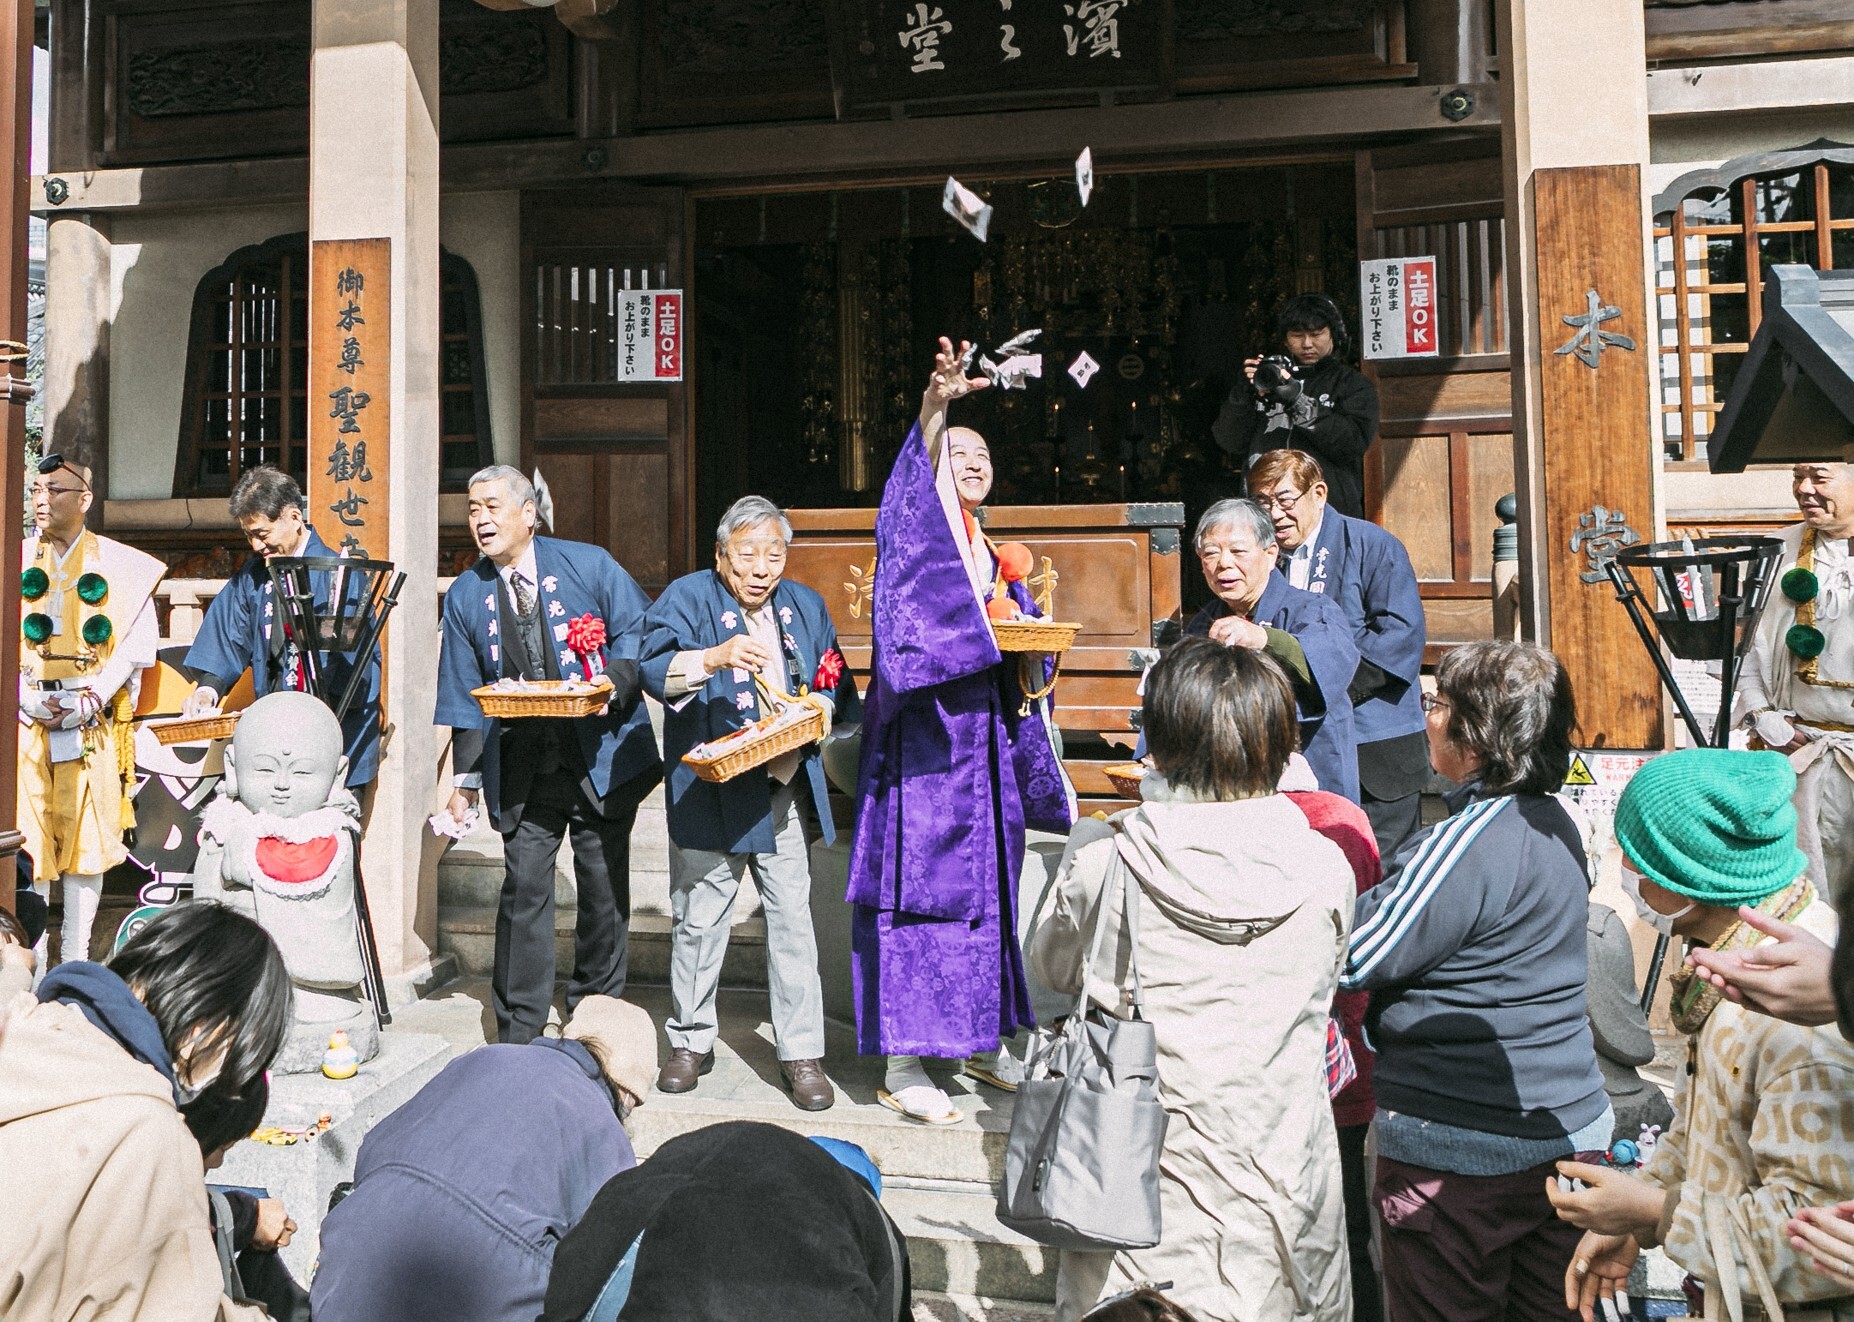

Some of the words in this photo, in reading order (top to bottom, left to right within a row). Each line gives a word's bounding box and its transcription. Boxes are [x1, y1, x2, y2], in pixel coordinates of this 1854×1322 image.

[640, 295, 652, 338] 靴のまま
[1369, 272, 1383, 353] お上がり下さい
[1386, 264, 1399, 311] 靴のまま
[1409, 270, 1429, 344] 土足OK
[624, 301, 636, 376] お上がり下さい
[659, 301, 677, 369] 土足OK
[1553, 290, 1641, 583] 本堂
[1601, 757, 1654, 771] 足元注
